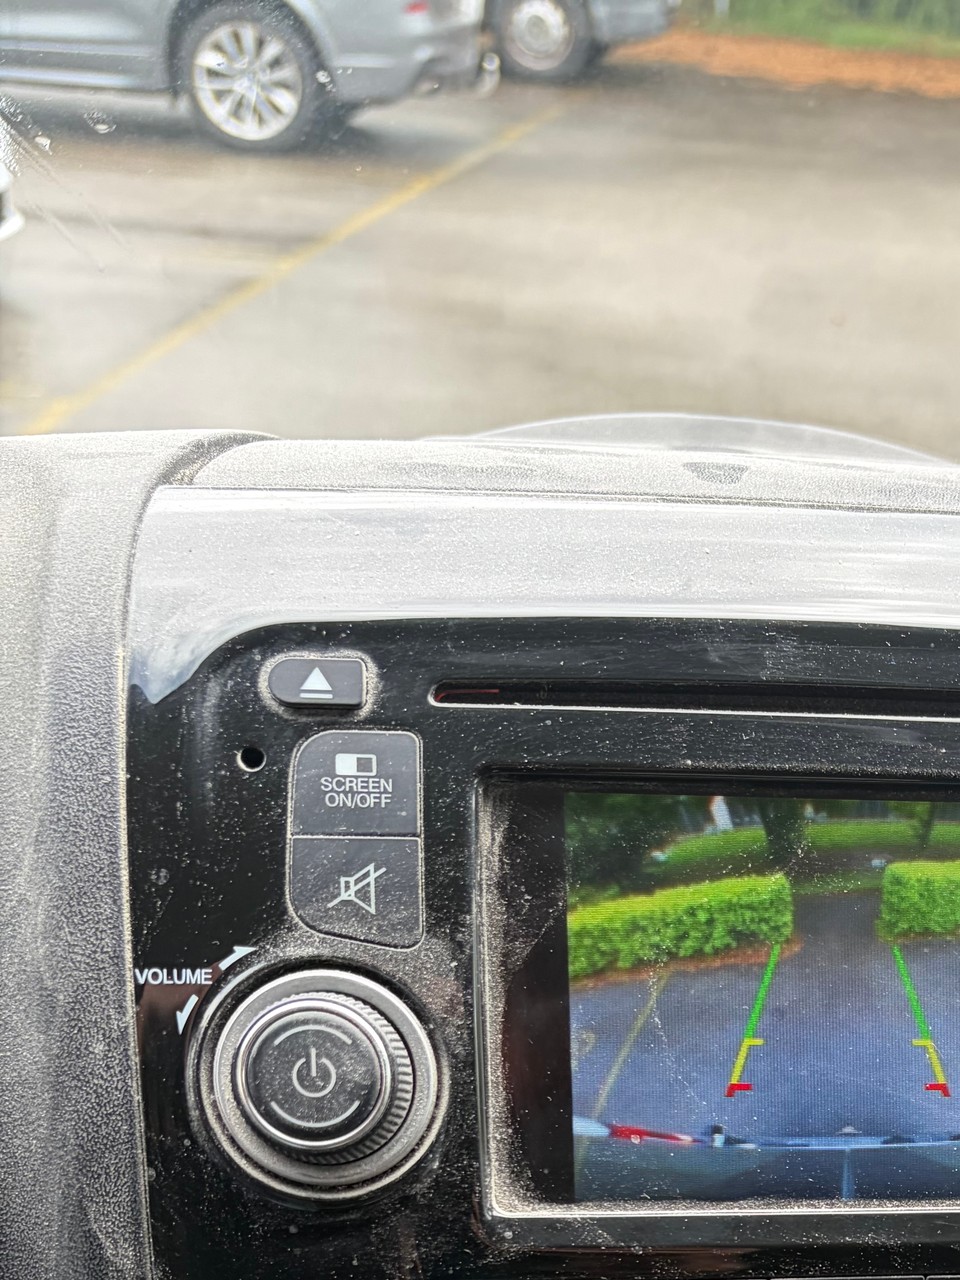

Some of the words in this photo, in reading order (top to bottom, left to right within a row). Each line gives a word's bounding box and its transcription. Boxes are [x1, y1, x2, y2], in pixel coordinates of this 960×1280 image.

[320, 777, 393, 793] SCREEN
[325, 792, 392, 809] ON/OFF
[134, 968, 213, 986] VOLUME
